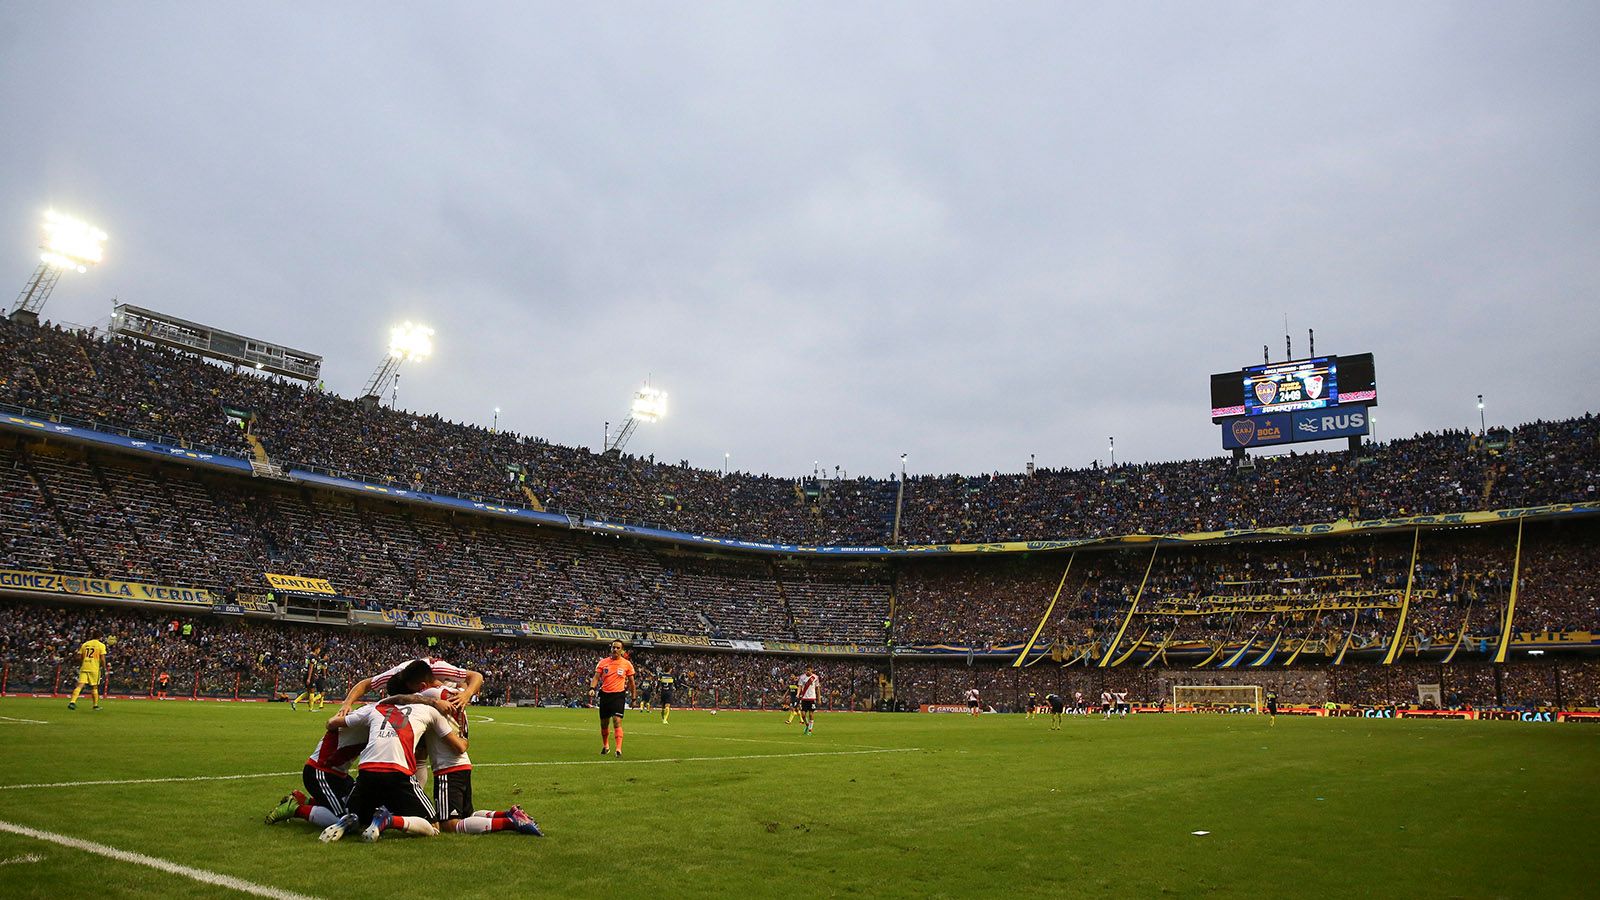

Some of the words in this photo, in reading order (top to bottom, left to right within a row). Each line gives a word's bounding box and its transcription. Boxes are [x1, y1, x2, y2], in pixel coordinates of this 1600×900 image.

[1322, 413, 1365, 431] RUS
[1257, 427, 1281, 437] BOCA
[1, 572, 56, 590] GOMEZ
[271, 576, 315, 590] SANTA
[315, 581, 332, 591] FE
[82, 579, 134, 597] ISLA
[142, 586, 210, 603] VERDE
[387, 609, 431, 623] MAROS
[433, 613, 473, 627] JUAREZ
[533, 623, 550, 633] SAN
[551, 625, 589, 636] CRISTOBAL
[85, 647, 95, 659] 12
[1365, 709, 1391, 718] GAS
[1522, 712, 1552, 722] GAS
